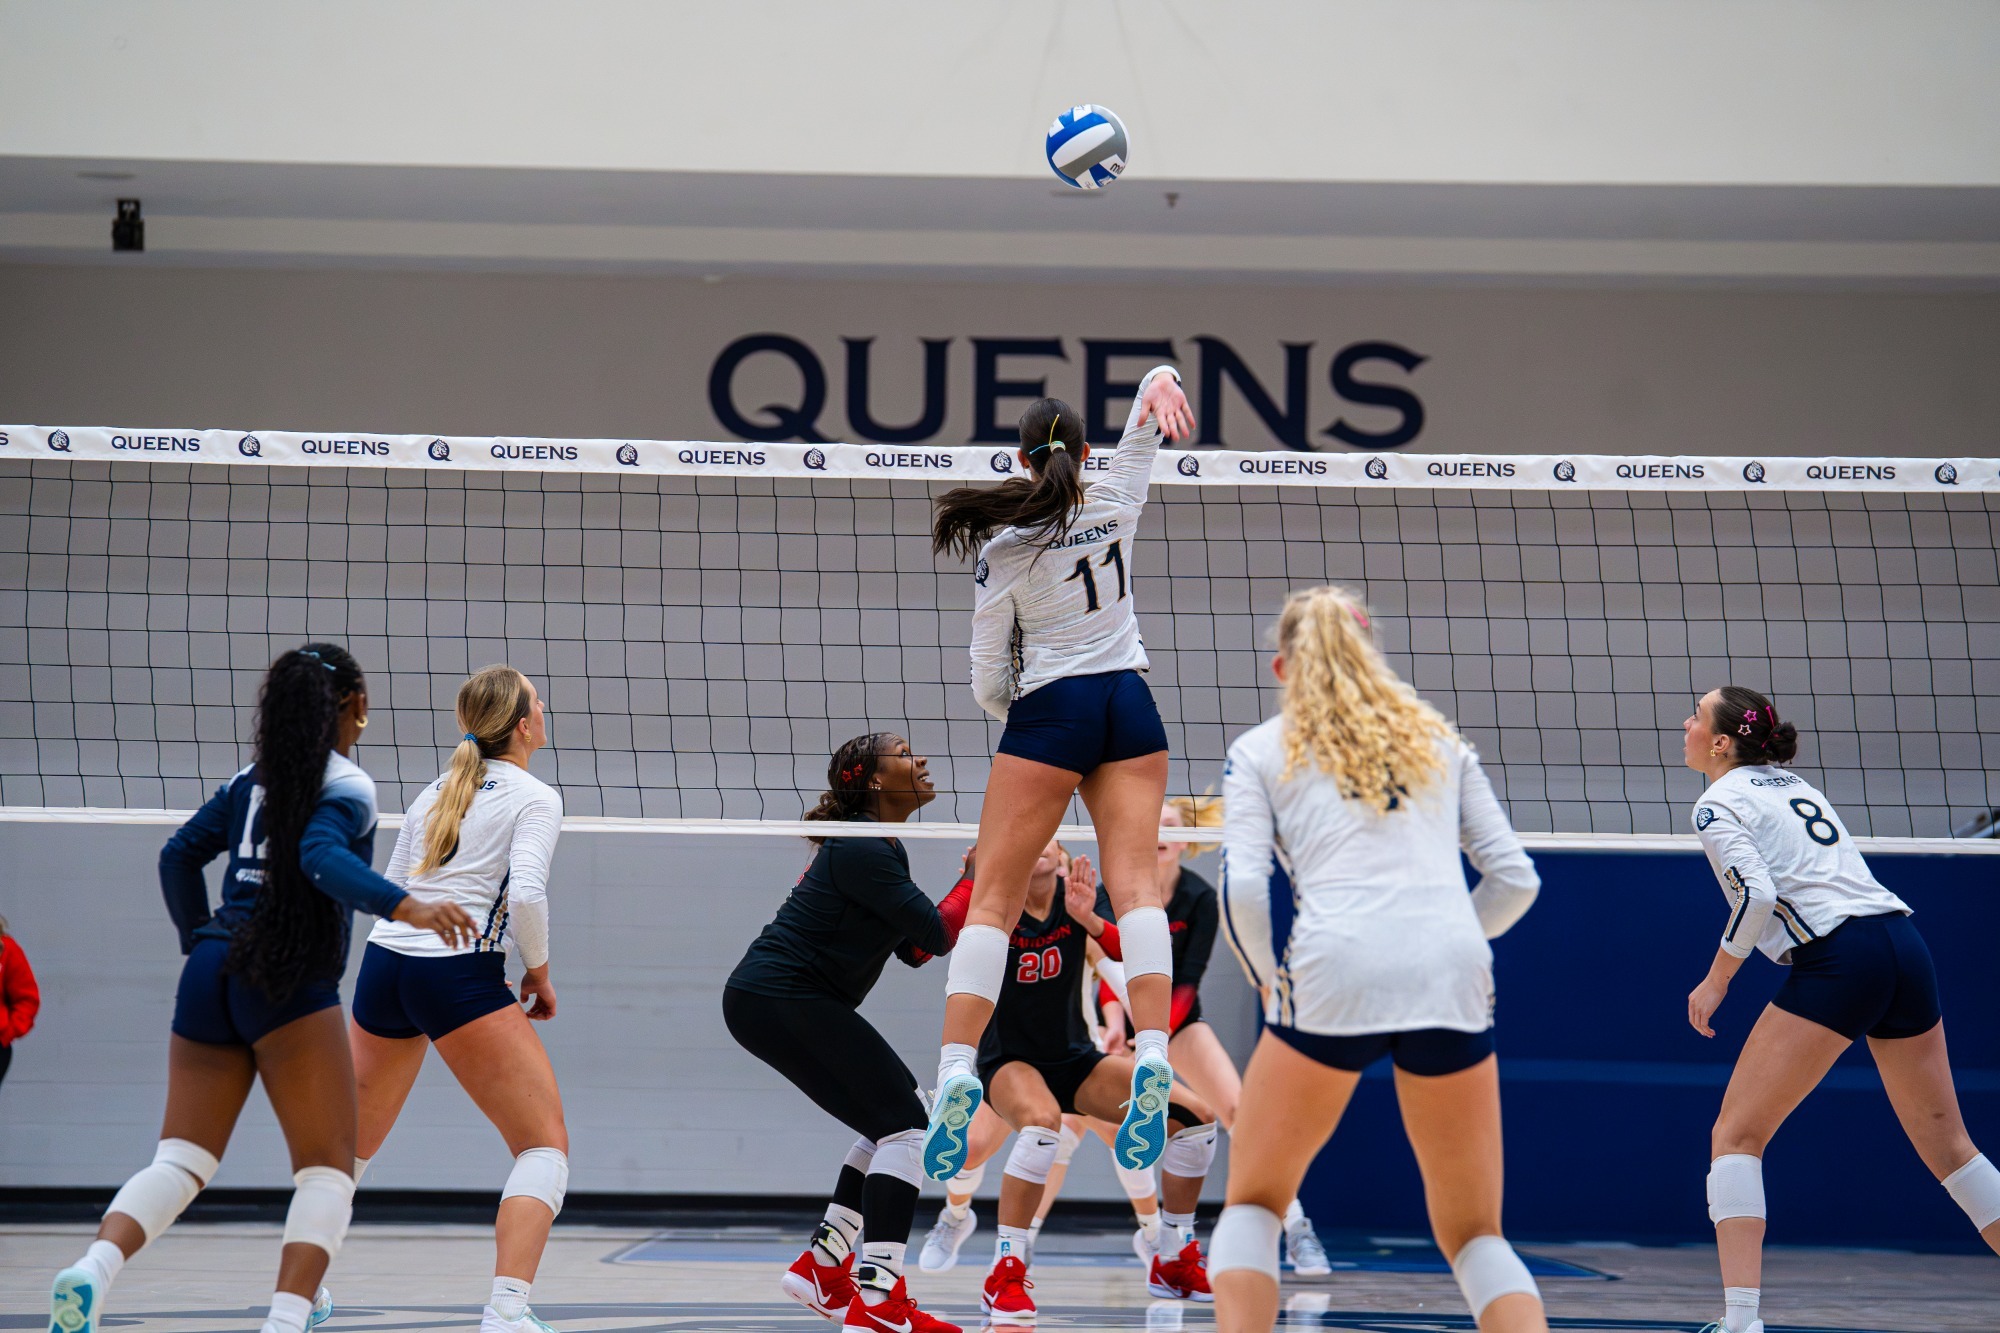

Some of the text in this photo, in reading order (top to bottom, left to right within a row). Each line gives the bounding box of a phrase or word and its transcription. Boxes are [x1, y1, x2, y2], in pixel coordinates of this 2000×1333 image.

[708, 332, 1430, 451] QUEENS
[111, 435, 201, 452] QUEENS
[301, 439, 390, 456] QUEENS
[490, 444, 578, 461] QUEENS
[678, 449, 766, 466] QUEENS
[865, 452, 953, 469] QUEENS
[1240, 459, 1327, 475] QUEENS
[1427, 462, 1517, 478] QUEENS
[1616, 464, 1705, 479] QUEENS
[1806, 465, 1896, 481] QUEENS
[1064, 538, 1127, 615] 11
[1750, 775, 1802, 788] QUEENS
[1788, 797, 1840, 847] 8
[1017, 946, 1063, 983] 20
